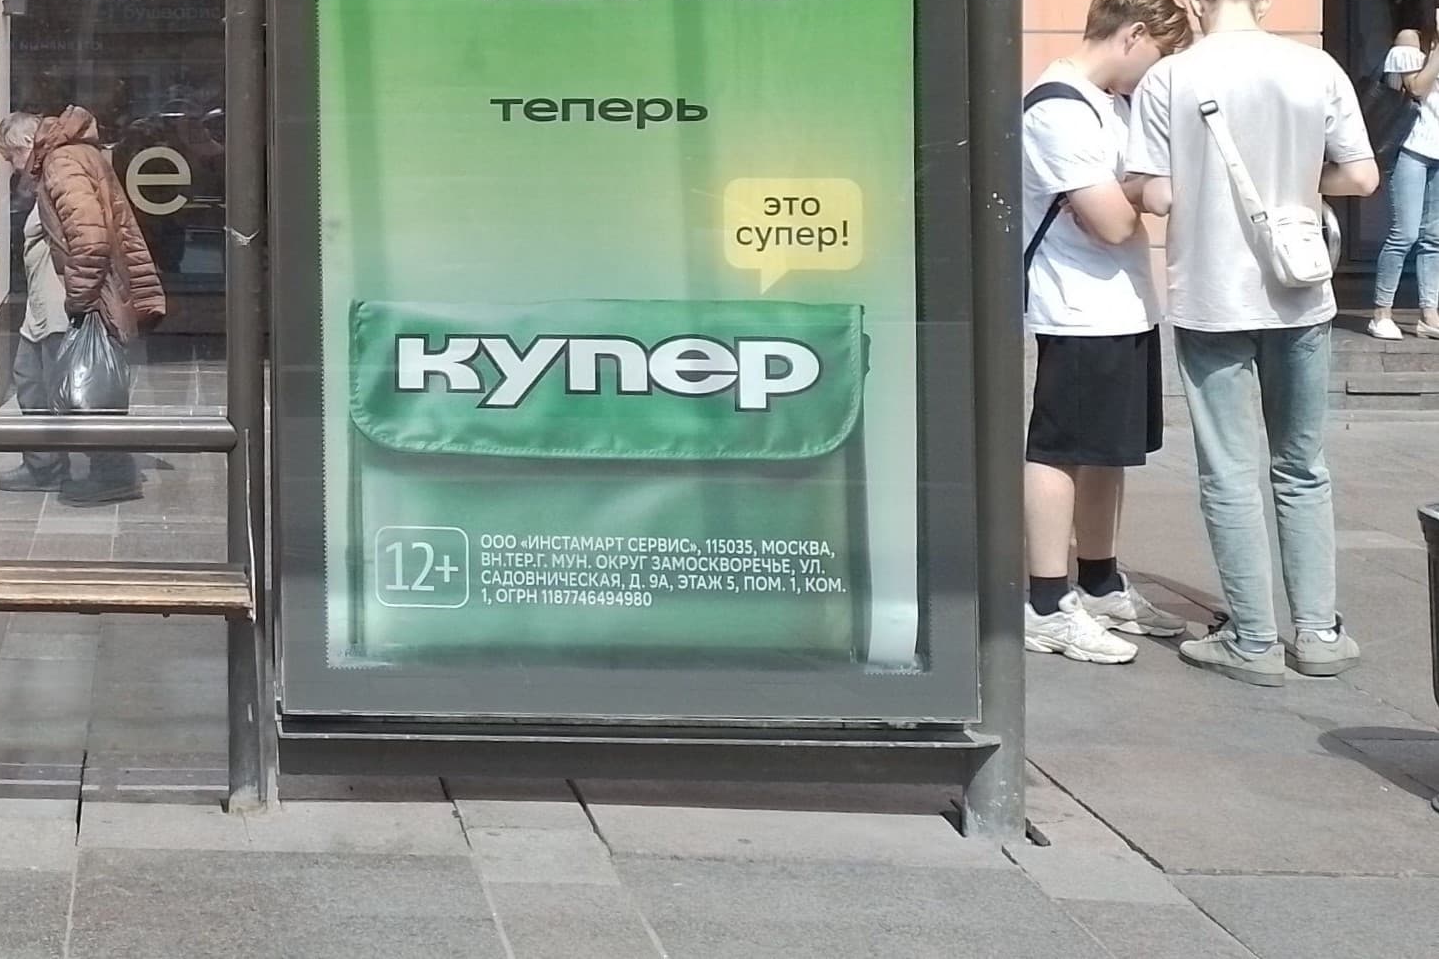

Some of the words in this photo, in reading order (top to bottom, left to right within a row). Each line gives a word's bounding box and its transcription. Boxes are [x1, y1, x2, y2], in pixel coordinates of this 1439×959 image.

[490, 97, 709, 130] теперь
[763, 196, 821, 216] это
[735, 220, 849, 252] супер!
[395, 334, 822, 412] купер
[480, 534, 517, 549] ООО
[520, 535, 624, 552] «ИНСТАМАРТ
[627, 537, 702, 555] СЕРВИС»,
[705, 539, 757, 557] 115035,
[761, 540, 835, 558] МОСКВА,
[384, 541, 459, 592] 12+
[481, 552, 547, 568] ВН.ТЕР.Г.
[551, 554, 592, 569] МУН.
[596, 554, 648, 571] ОКРУГ
[651, 556, 796, 575] ЗАМОСКВОРЕЧЬЕ,
[799, 558, 825, 575] УЛ.
[480, 570, 625, 590] САДОВНИЧЕСКАЯ,
[628, 573, 645, 591] Д.
[648, 574, 674, 592] 9А,
[677, 574, 723, 591] ЭТАЖ
[726, 575, 739, 593] 5,
[744, 576, 786, 591] ПОМ.
[790, 577, 801, 594] 1,
[804, 577, 847, 593] КОМ.
[481, 588, 492, 605] 1,
[495, 588, 538, 604] ОГРН
[541, 589, 653, 607] 1187746494980
